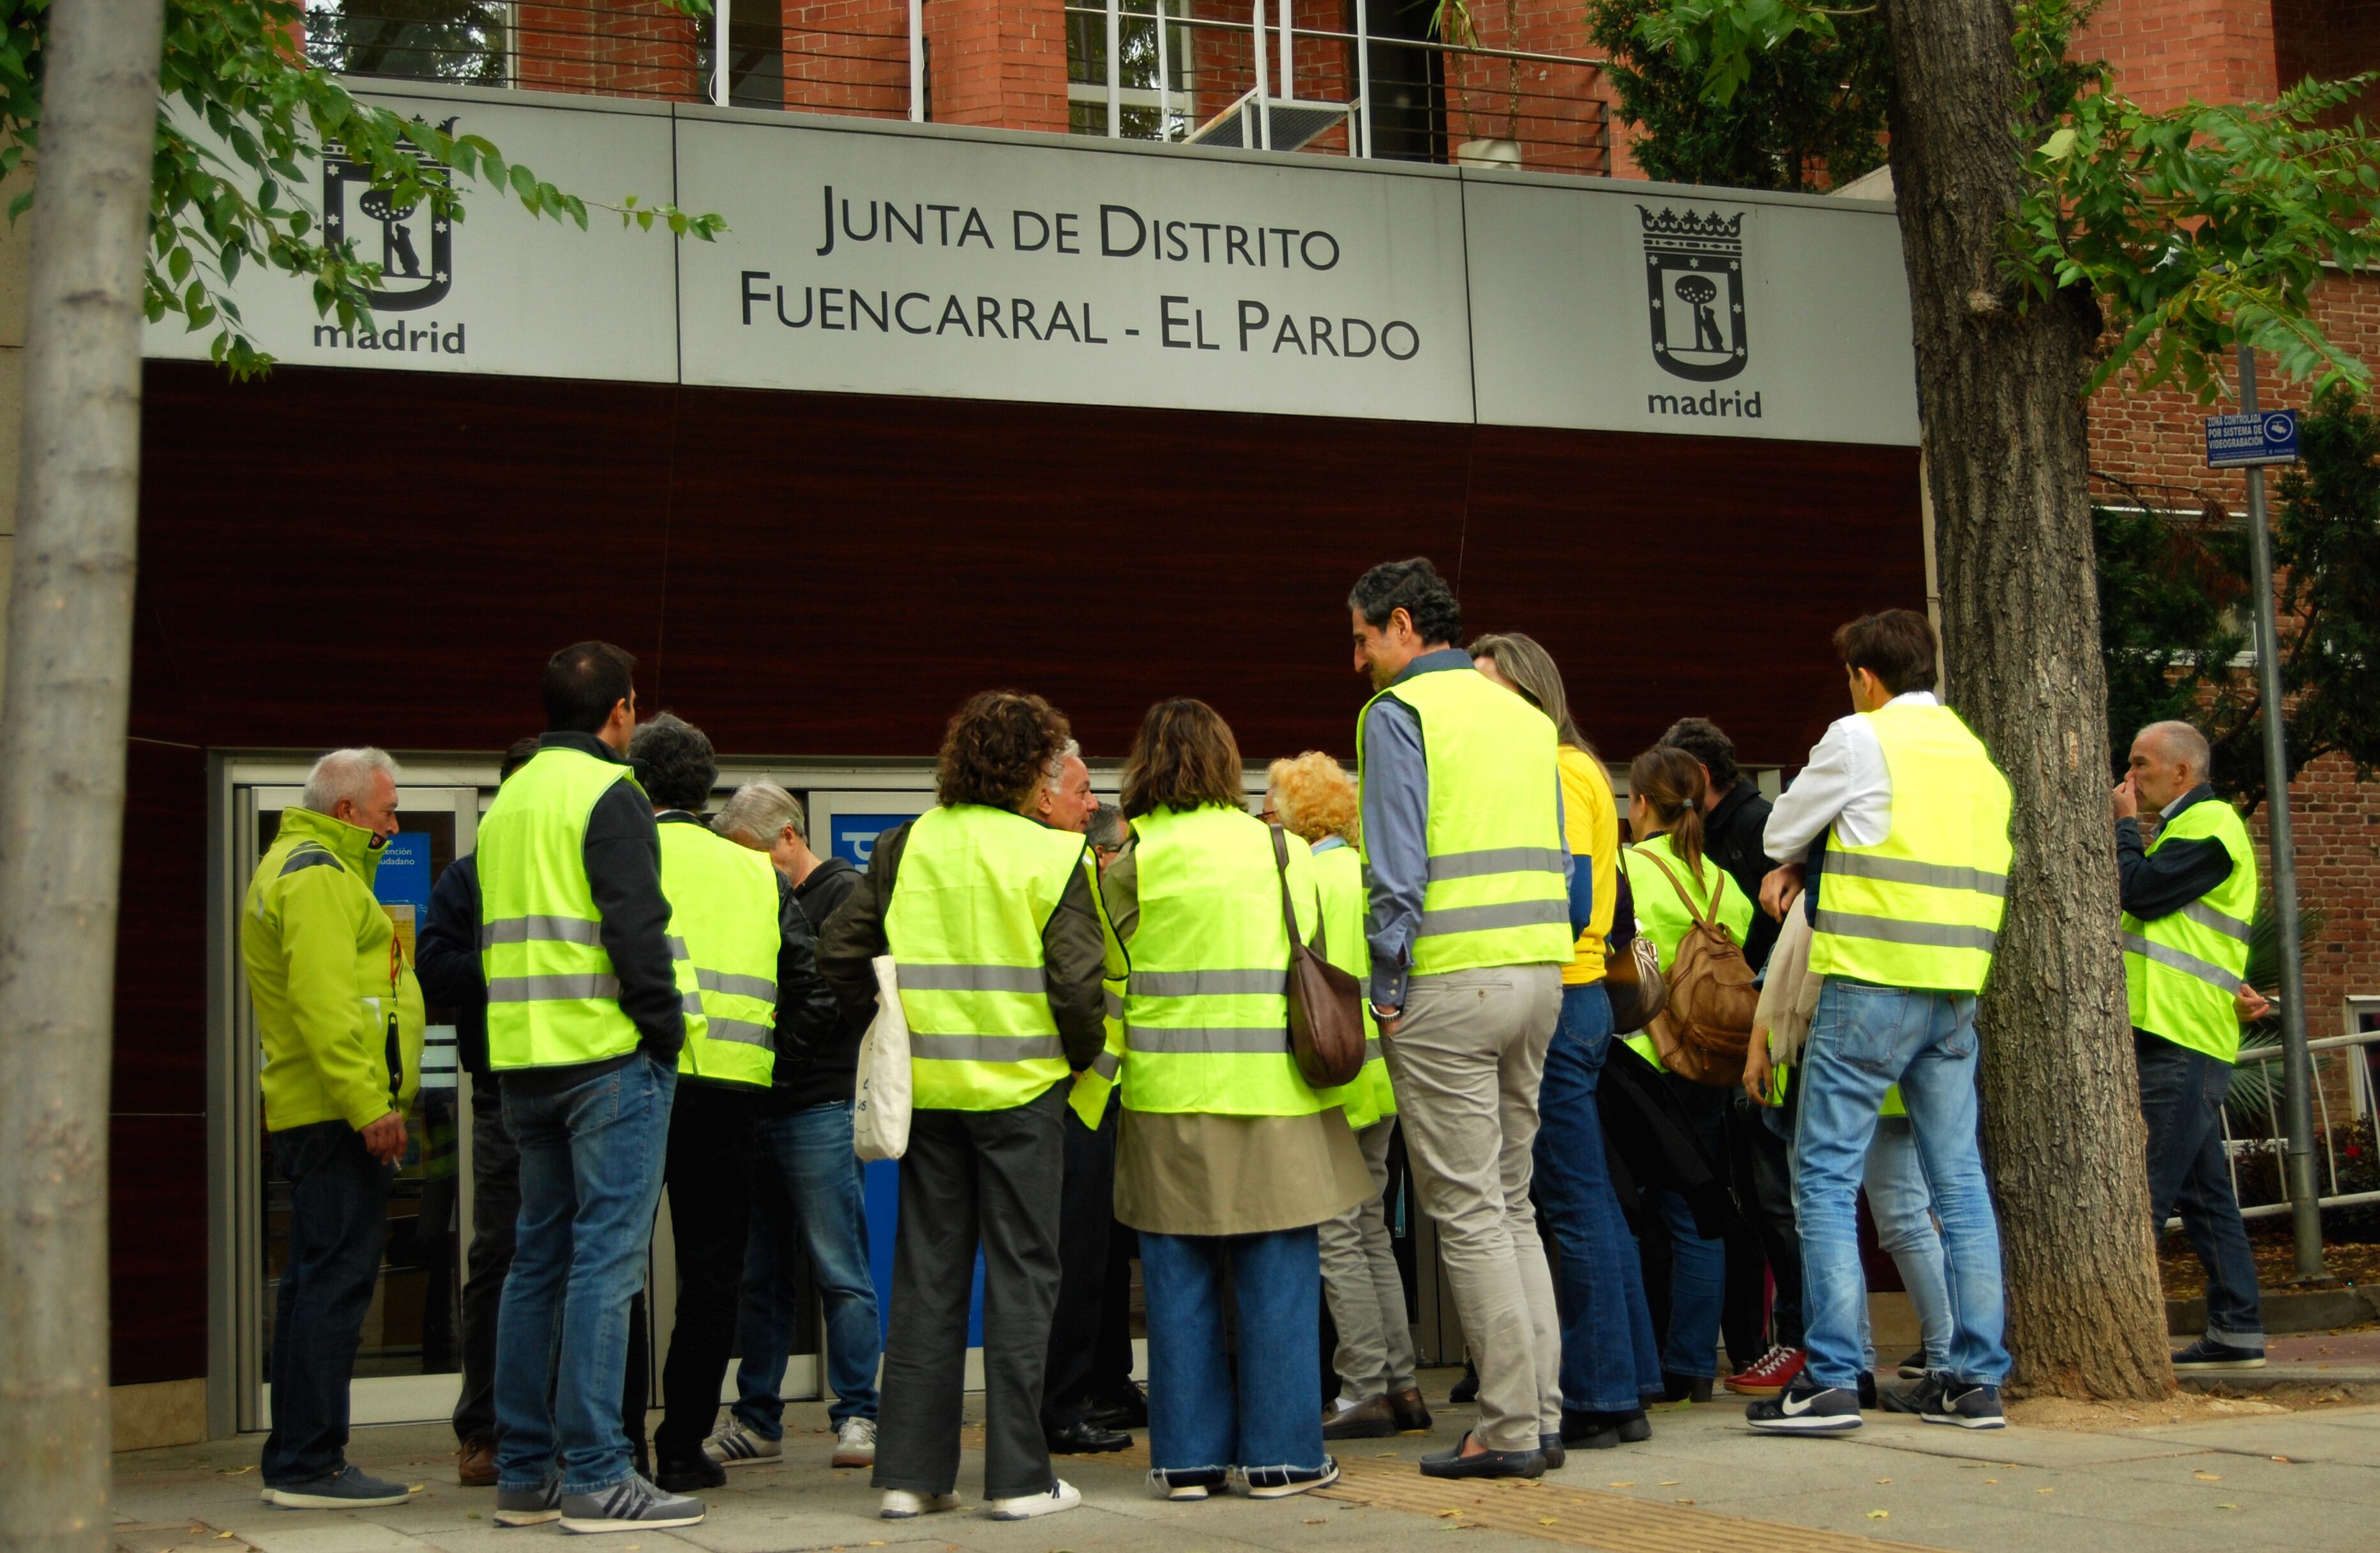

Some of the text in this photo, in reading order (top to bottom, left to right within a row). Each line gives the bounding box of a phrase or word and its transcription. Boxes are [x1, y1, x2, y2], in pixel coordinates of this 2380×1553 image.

[817, 186, 1339, 270] JUNTA DE DISTRITO
[742, 271, 1107, 344] FUENCARRAL
[1161, 296, 1219, 350] EL
[1239, 300, 1419, 360] PARDO
[313, 319, 465, 354] madrid
[1648, 390, 1761, 418] madrid
[2208, 414, 2262, 427] ZONA CONTROLADA
[2208, 425, 2263, 438] POR SISTEMA DE
